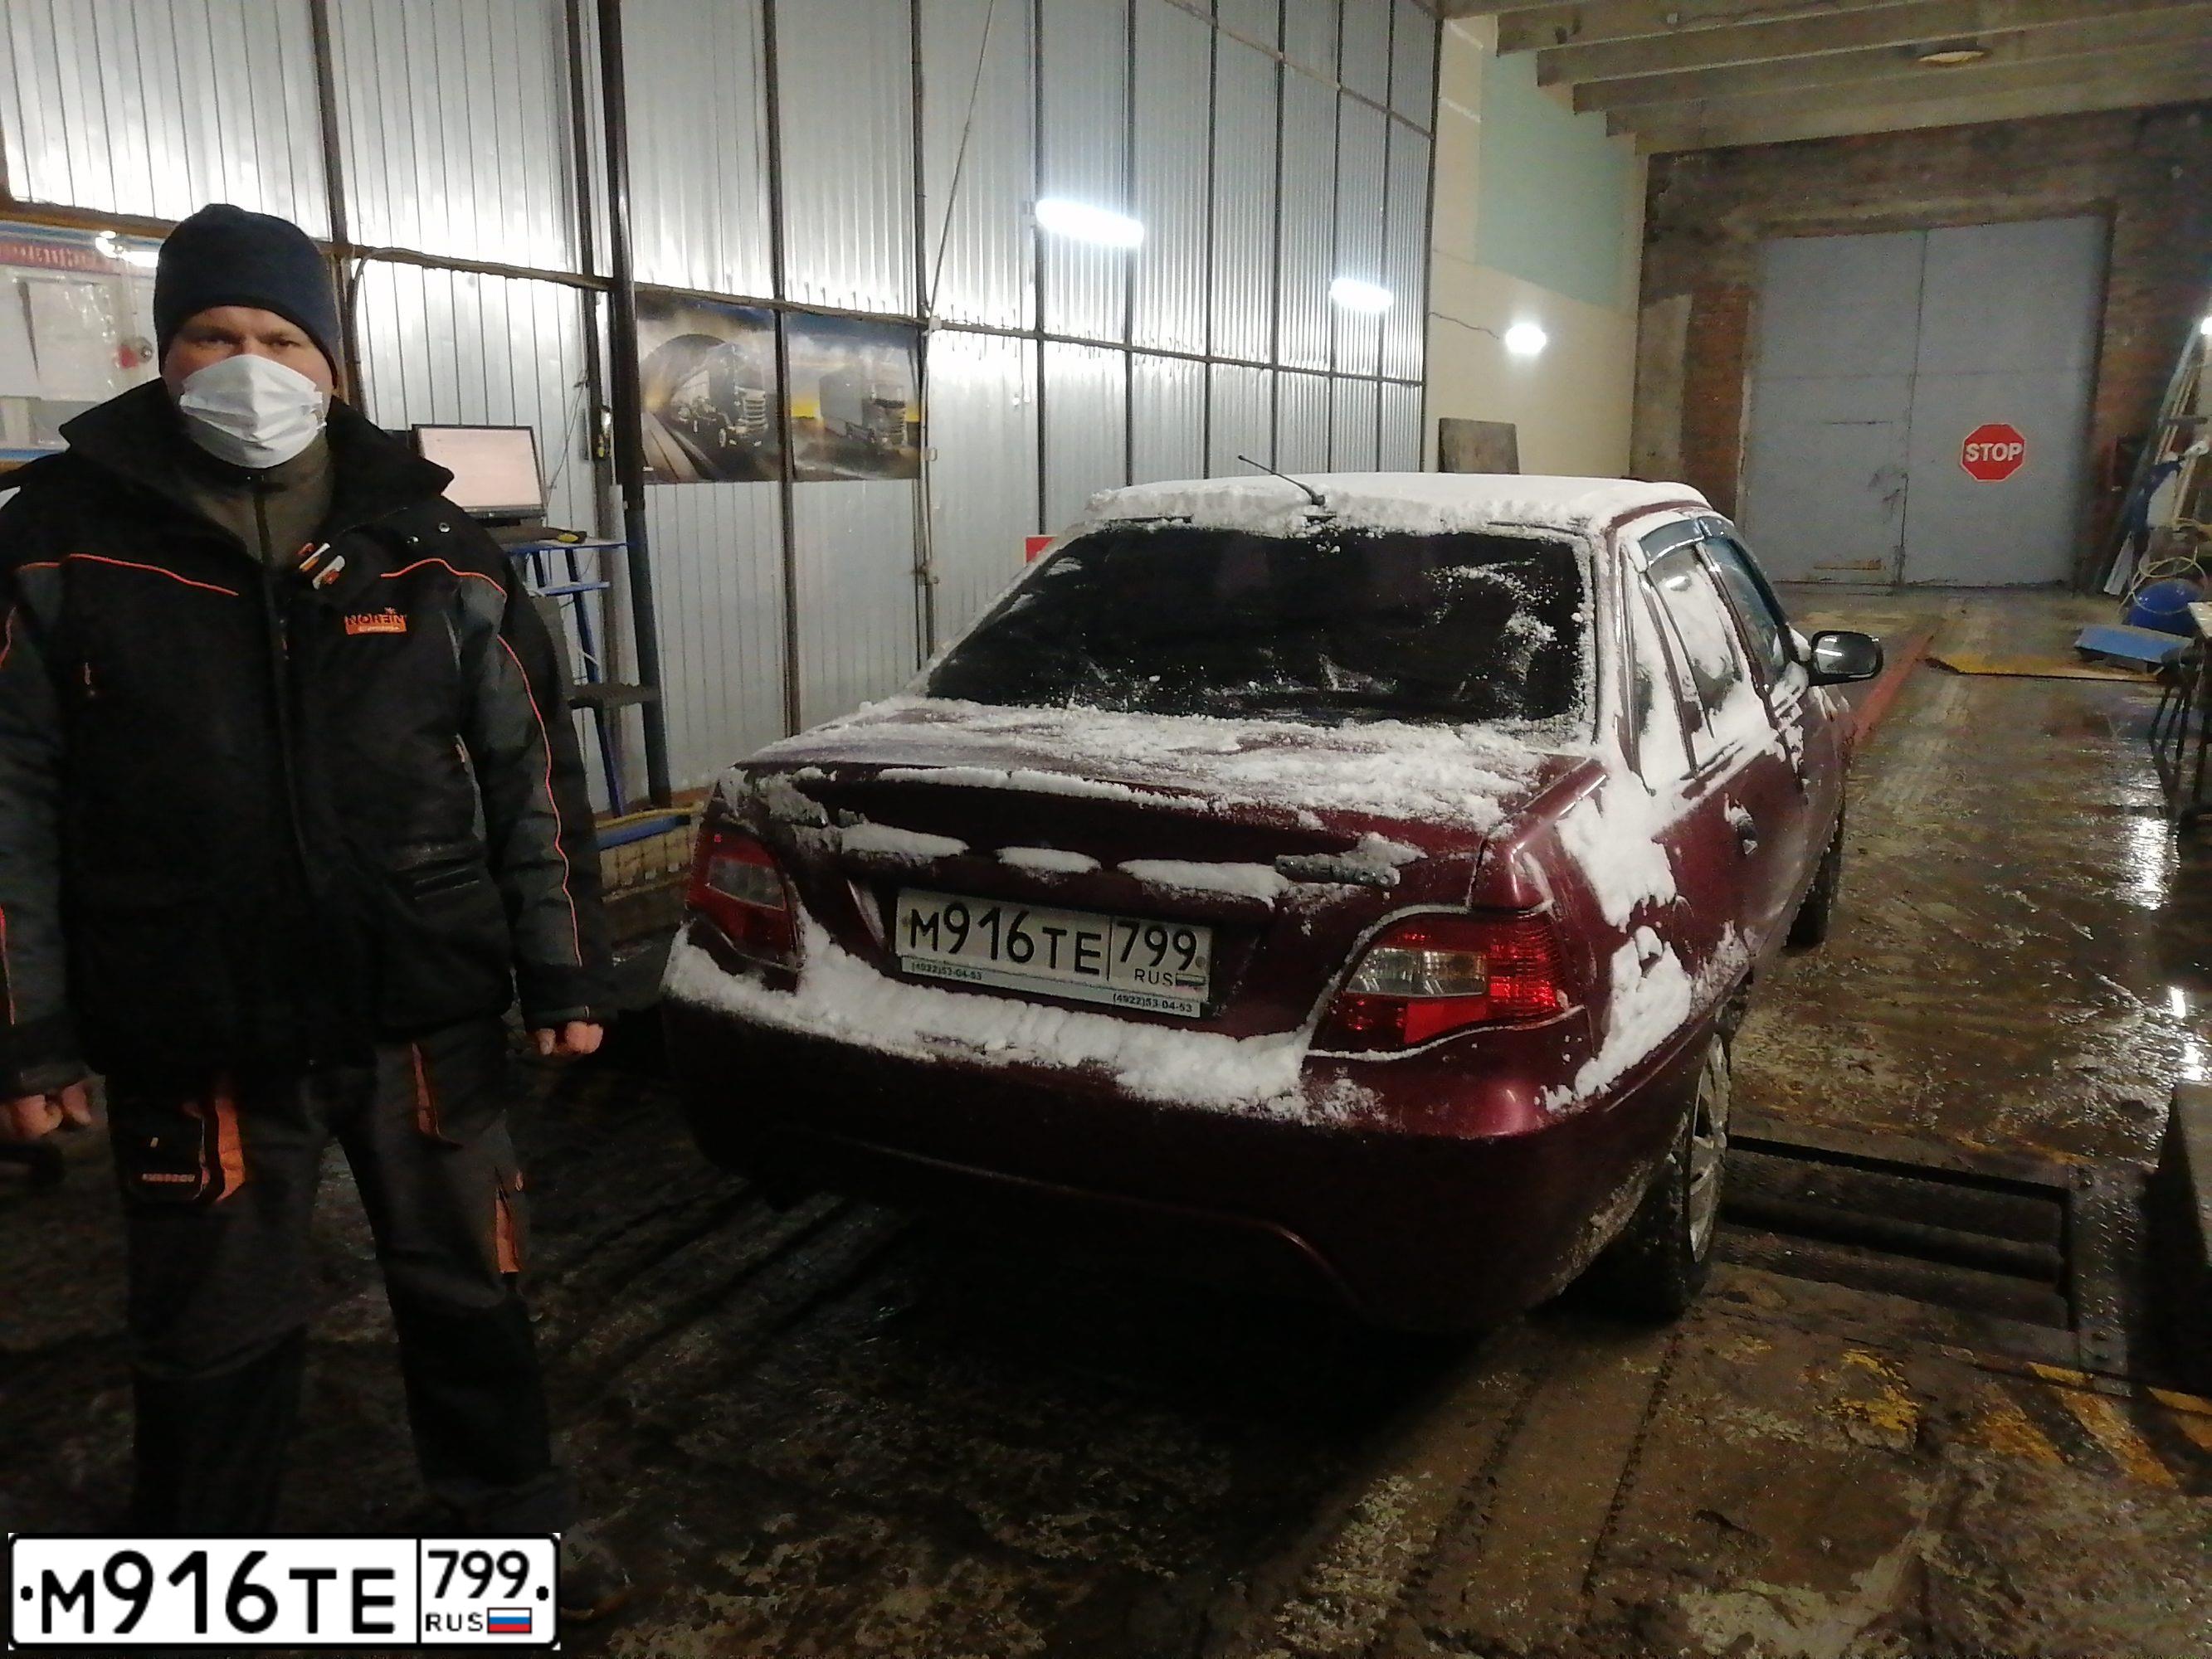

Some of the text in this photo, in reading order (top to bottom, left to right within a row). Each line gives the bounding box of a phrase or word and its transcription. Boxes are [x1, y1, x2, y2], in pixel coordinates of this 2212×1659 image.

[1966, 442, 2023, 462] STOP
[1116, 921, 1197, 971] 799
[1134, 968, 1173, 986] RUS
